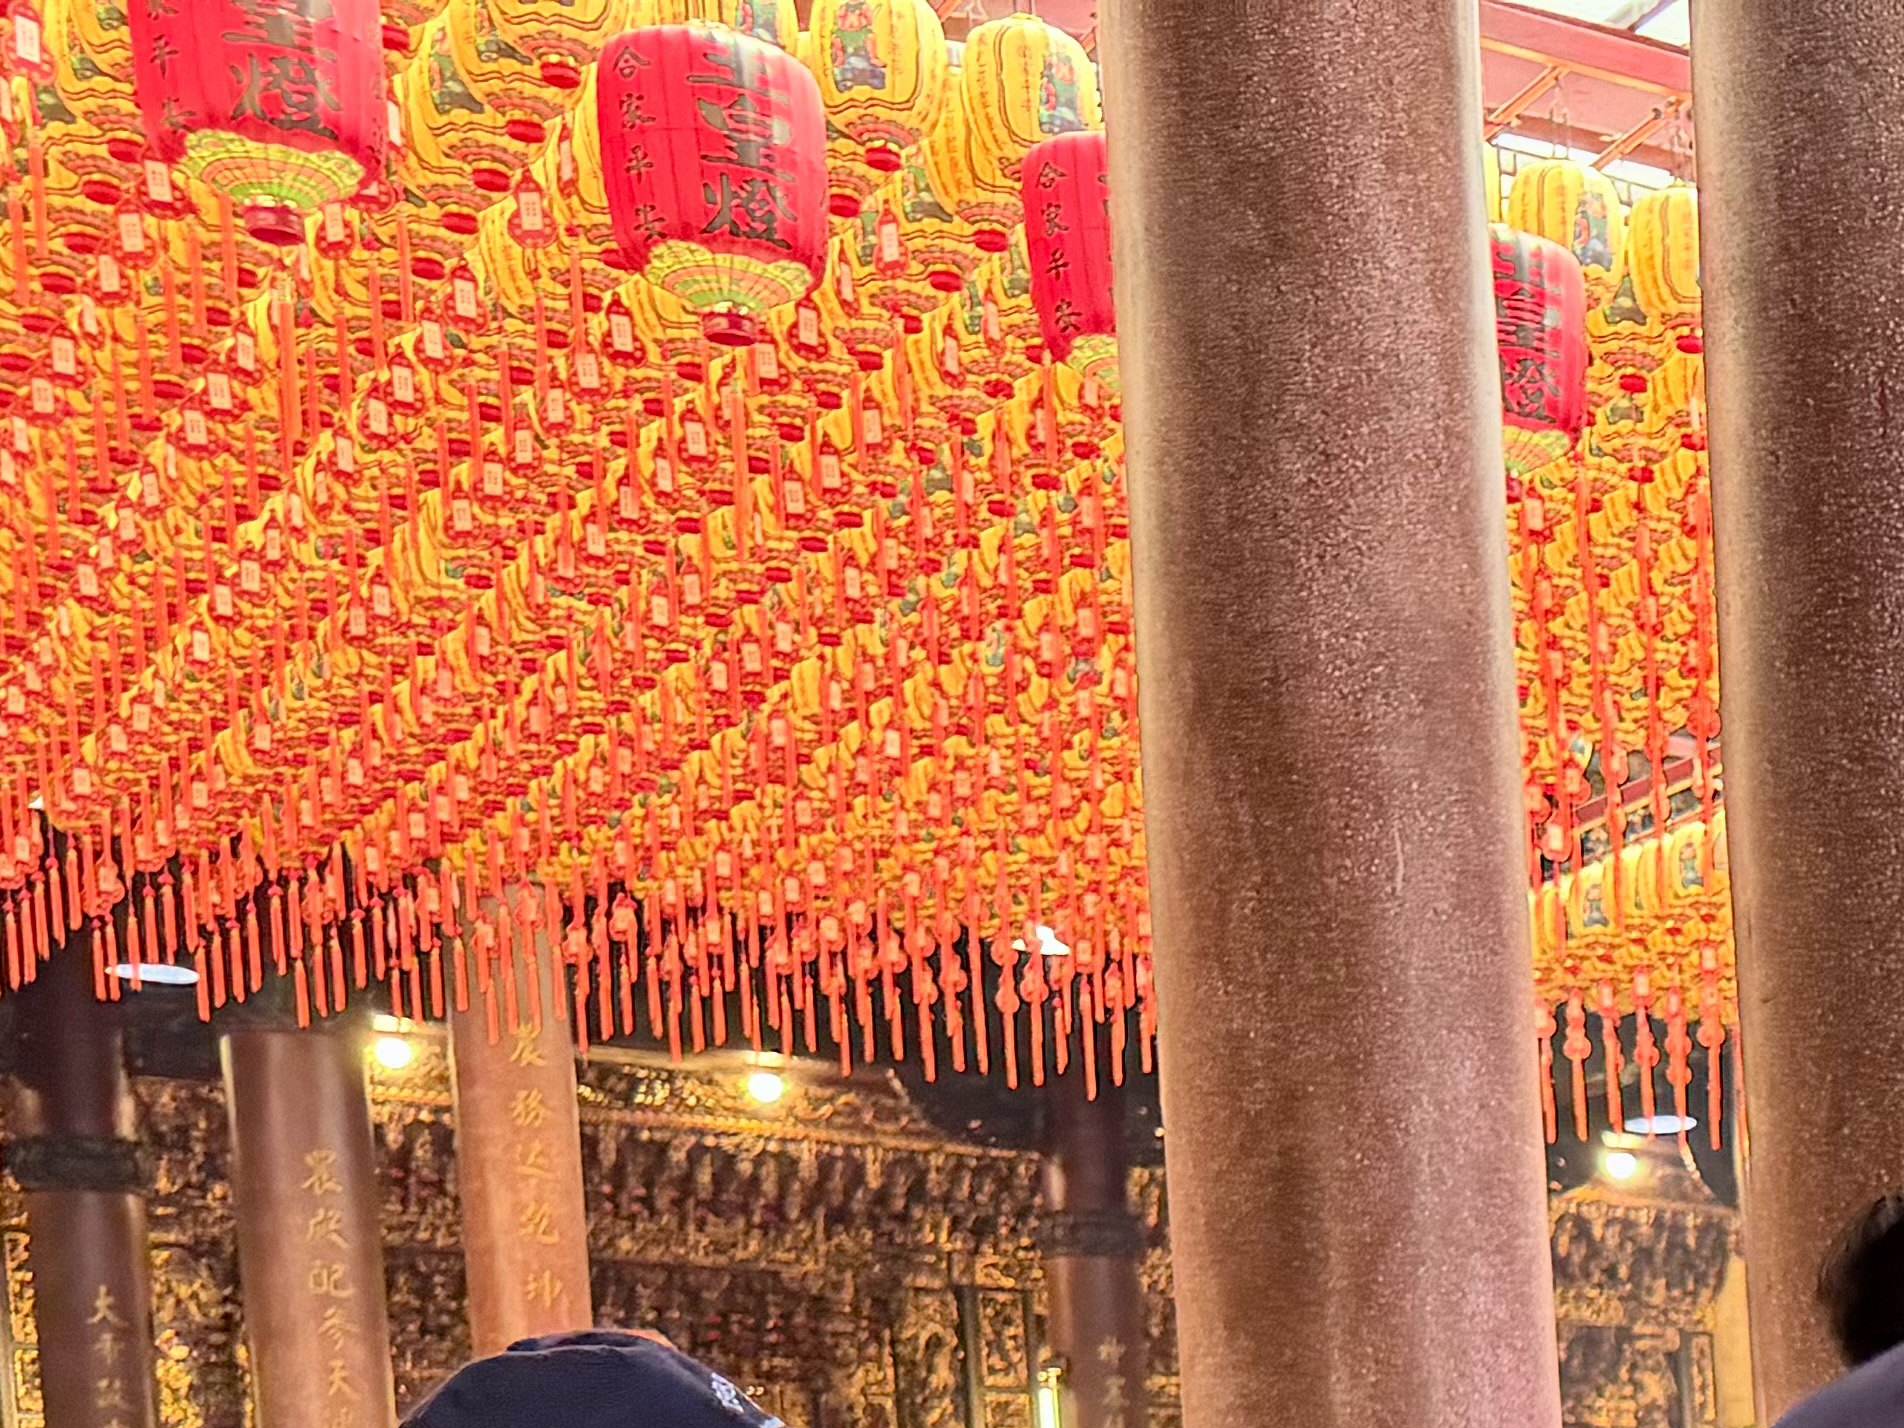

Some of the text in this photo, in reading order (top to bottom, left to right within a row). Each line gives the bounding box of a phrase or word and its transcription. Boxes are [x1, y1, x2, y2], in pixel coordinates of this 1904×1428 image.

[613, 45, 668, 242] 合家平安
[1036, 161, 1083, 332] 合家平安
